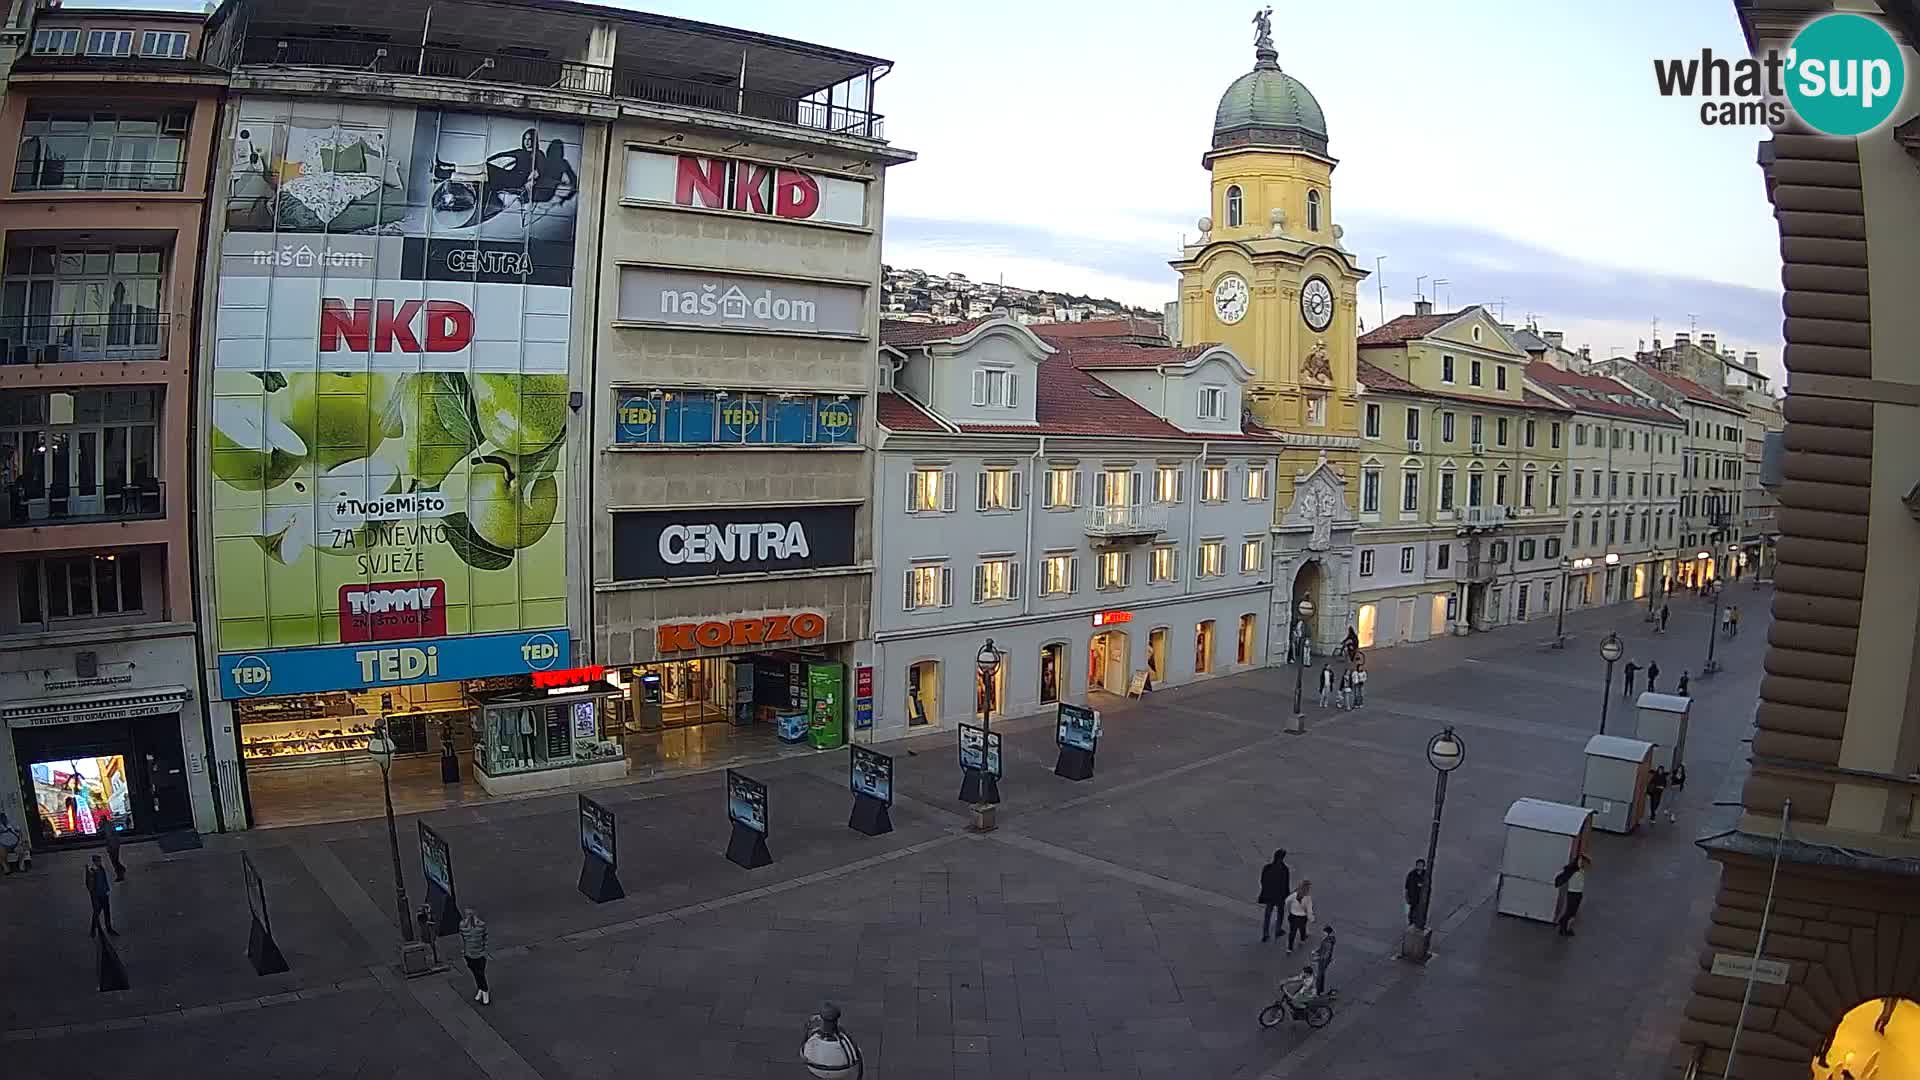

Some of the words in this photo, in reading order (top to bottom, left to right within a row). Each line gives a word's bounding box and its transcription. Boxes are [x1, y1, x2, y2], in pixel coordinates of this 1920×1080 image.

[675, 155, 820, 219] NKD
[252, 244, 294, 267] naš
[318, 247, 364, 268] dom
[446, 249, 534, 275] CENTRA
[660, 284, 717, 316] naš
[753, 290, 816, 323] dom
[320, 297, 475, 353] NKD
[618, 406, 657, 426] TEDi
[722, 408, 759, 426] TEDi
[820, 410, 853, 427] TEDi
[336, 496, 445, 517] #TvojeMisto
[331, 528, 356, 549] ZA
[364, 524, 450, 547] DNEVNO
[658, 521, 810, 565] CENTRA
[357, 548, 425, 576] SVJEŽE
[347, 586, 438, 615] TOMMY
[656, 613, 825, 653] KORZO
[521, 642, 559, 662] TEDi
[231, 664, 272, 686] TEDi
[355, 646, 440, 685] TEDi
